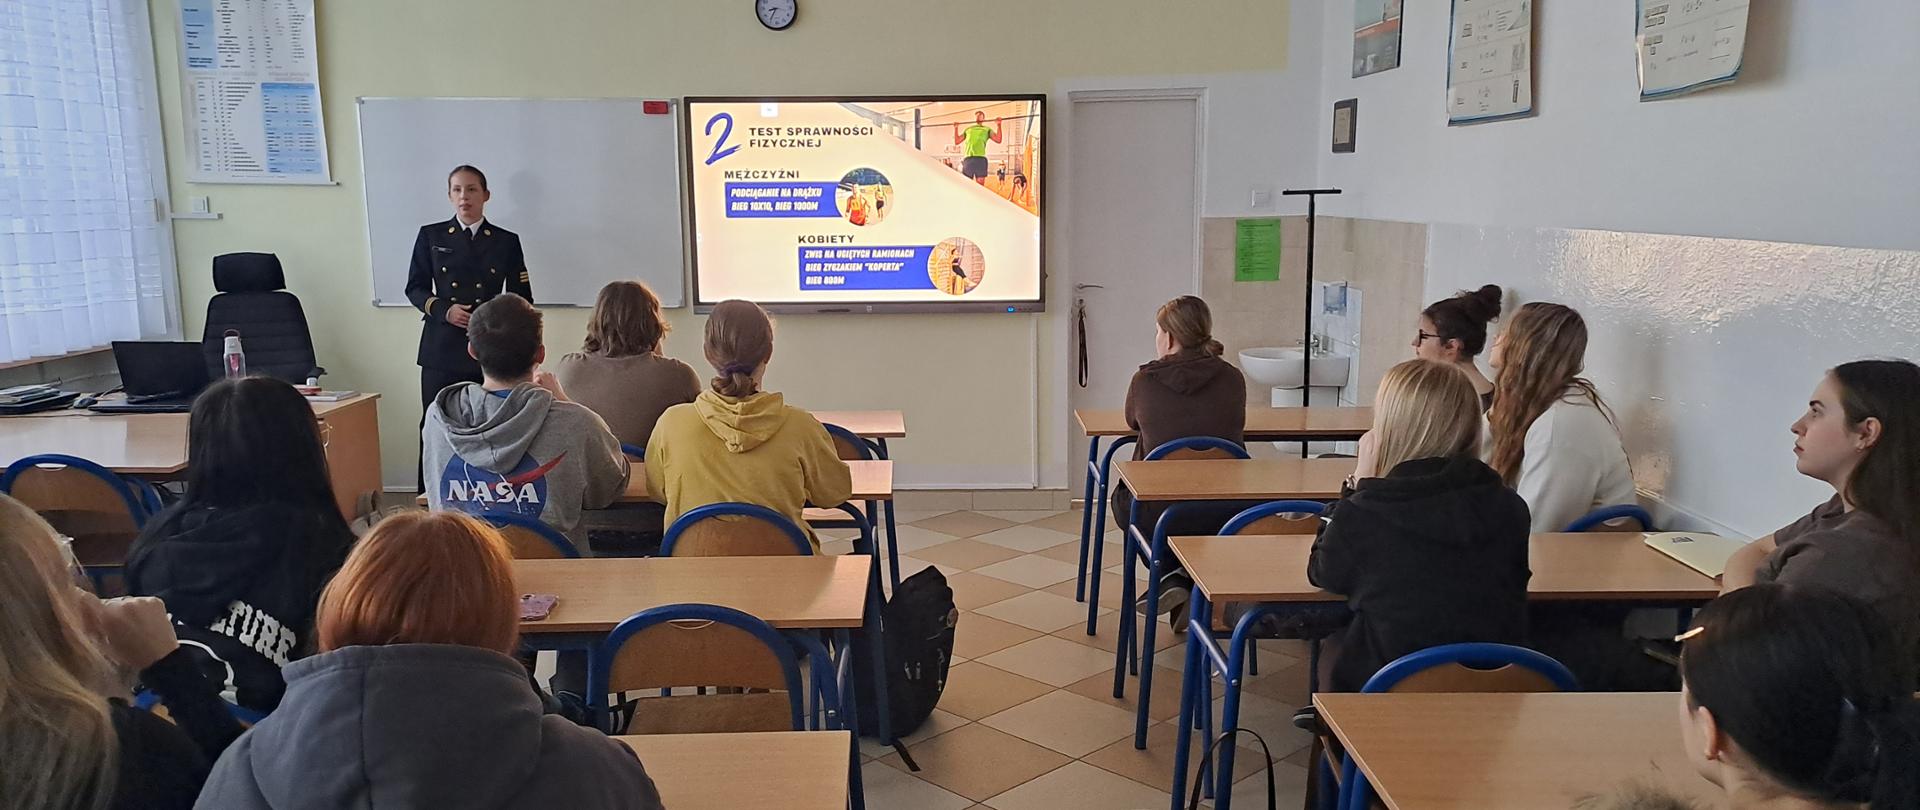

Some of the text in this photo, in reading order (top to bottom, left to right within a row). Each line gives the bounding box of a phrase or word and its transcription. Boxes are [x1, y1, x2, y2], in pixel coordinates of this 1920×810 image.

[749, 125, 873, 136] TEST SPRAWNOŚCI
[705, 112, 742, 166] 2
[749, 138, 822, 148] FIZYCZNEJ
[724, 168, 800, 181] MĘŻCZYŹNI
[731, 186, 822, 199] PODCIĄGANIE NA DRĄŻKU
[731, 201, 819, 212] BIEG 10X10, BIEG 1000M
[798, 235, 855, 244] KOBIETY
[804, 249, 915, 260] ZWIS NA UGIĘTYCH RAMIONACH
[805, 263, 822, 272] BIEG
[823, 262, 863, 272] ZYGZAKIEM
[805, 276, 845, 285] BIEG 800M
[447, 479, 540, 504] NASA
